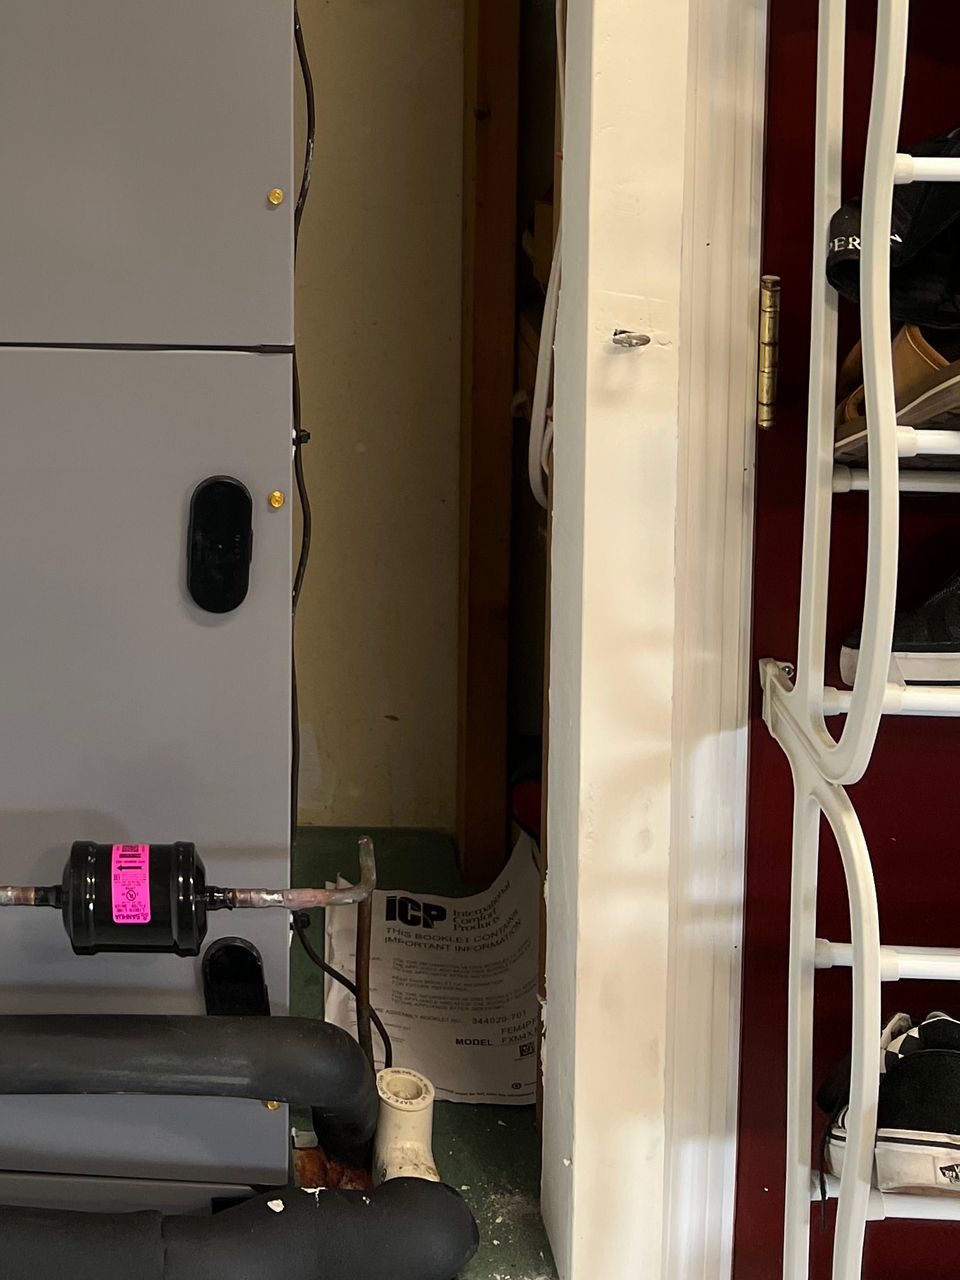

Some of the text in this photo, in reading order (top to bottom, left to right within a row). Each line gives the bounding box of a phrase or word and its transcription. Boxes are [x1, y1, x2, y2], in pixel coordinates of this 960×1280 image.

[385, 896, 447, 929] ICP
[385, 919, 522, 953] IMPORTANT INFORMATION
[387, 928, 411, 939] THIS
[415, 931, 469, 944] BOOKLET
[455, 1038, 494, 1046] MODEL
